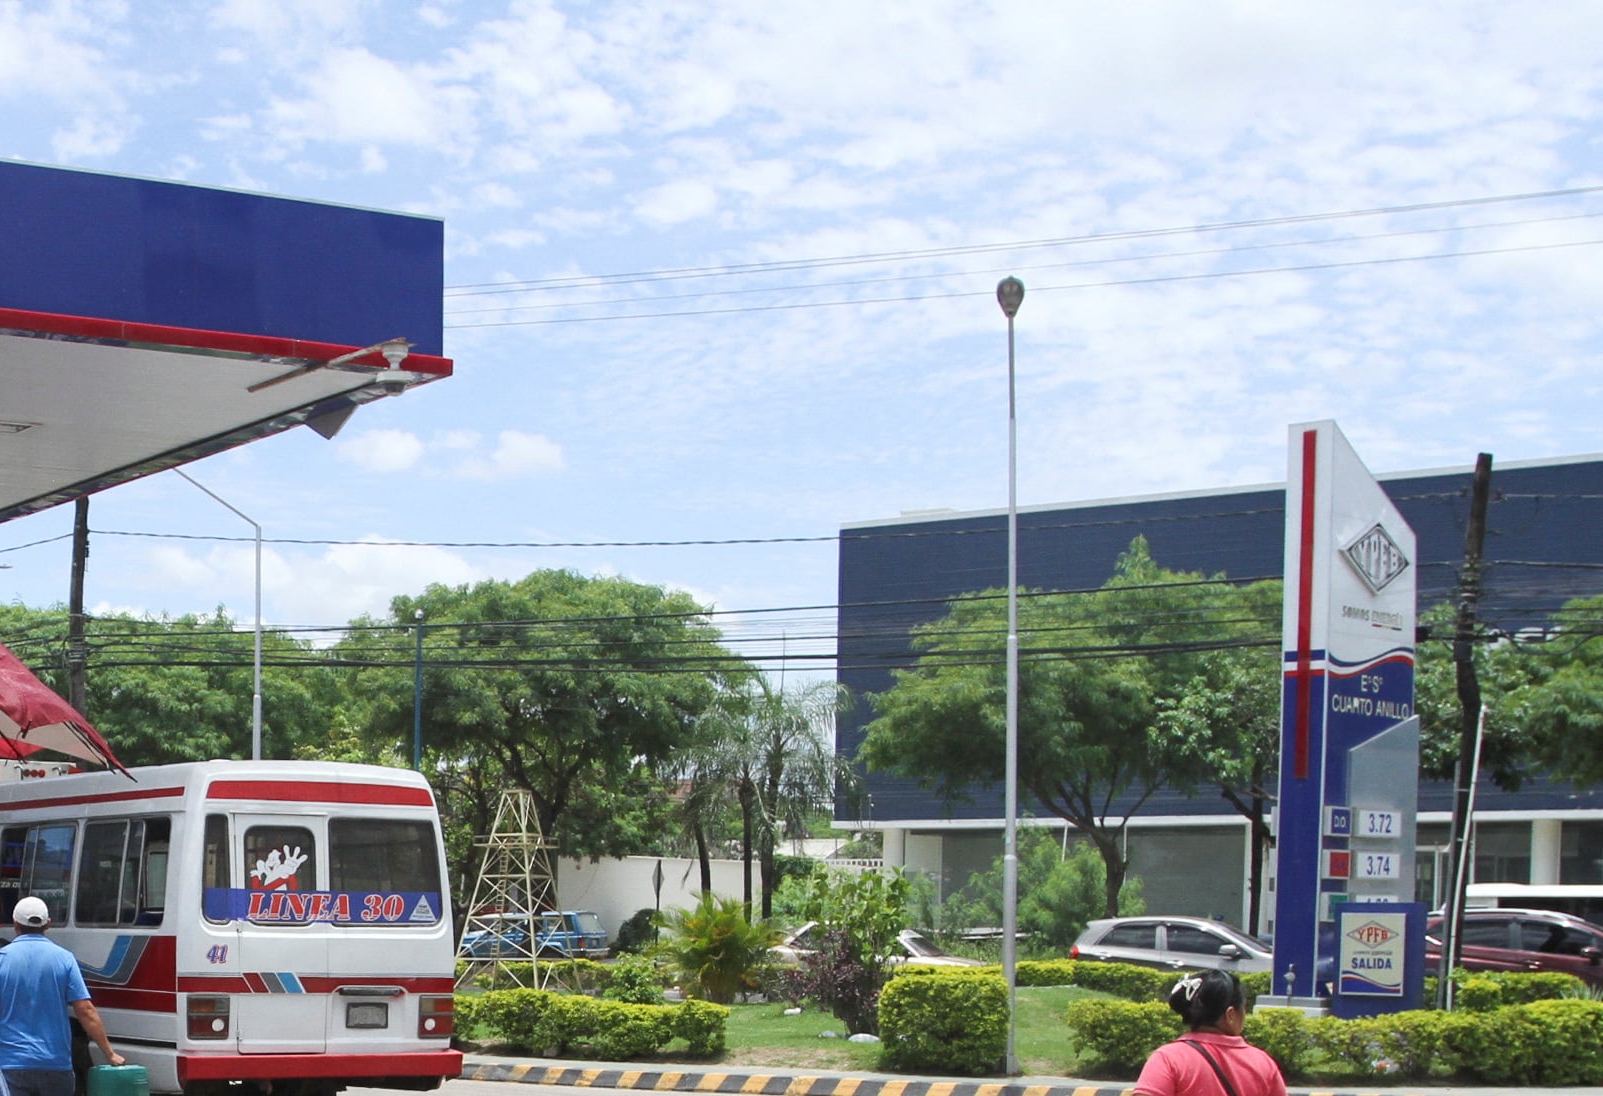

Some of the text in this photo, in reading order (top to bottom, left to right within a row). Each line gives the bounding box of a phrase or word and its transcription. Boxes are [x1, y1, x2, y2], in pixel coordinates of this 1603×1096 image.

[1332, 694, 1409, 720] CUARTO ANILLO
[1368, 813, 1392, 833] 3.72
[1366, 856, 1390, 875] 3.74
[248, 893, 351, 921] LINEA
[361, 895, 405, 921] 30
[1357, 927, 1388, 943] YPFB
[206, 945, 228, 964] 41
[1351, 957, 1392, 970] SALIDA
